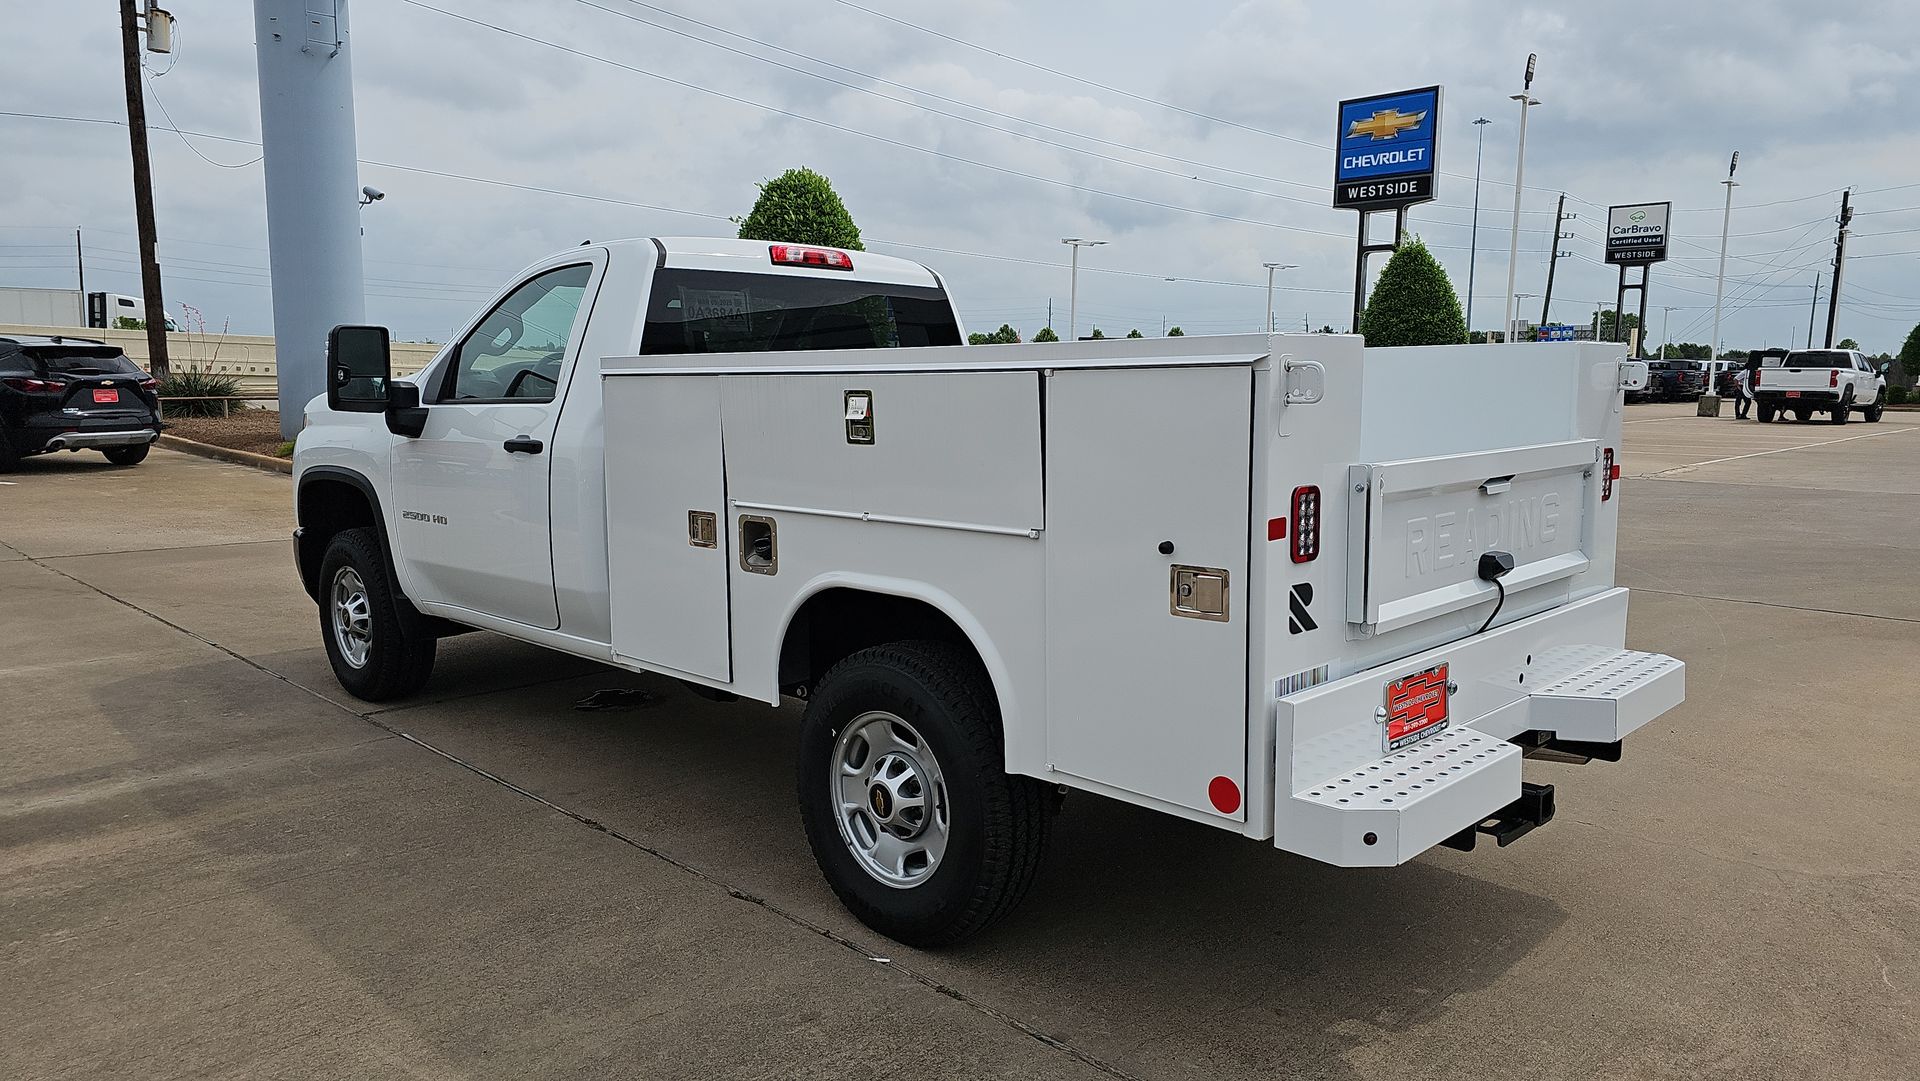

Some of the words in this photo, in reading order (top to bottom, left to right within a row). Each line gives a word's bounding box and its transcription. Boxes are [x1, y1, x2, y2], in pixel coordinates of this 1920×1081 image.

[1343, 148, 1425, 169] CHEVROLET
[1348, 181, 1418, 199] WESTSIDE
[1612, 225, 1662, 235] CarBravo
[1611, 237, 1642, 245] Certified
[1614, 250, 1656, 259] WESTSIDE
[402, 510, 430, 522] 2500
[432, 514, 448, 525] HD
[1405, 492, 1560, 578] READING
[1400, 733, 1420, 747] WESTSIDE
[1420, 723, 1441, 739] CHEVROLET
